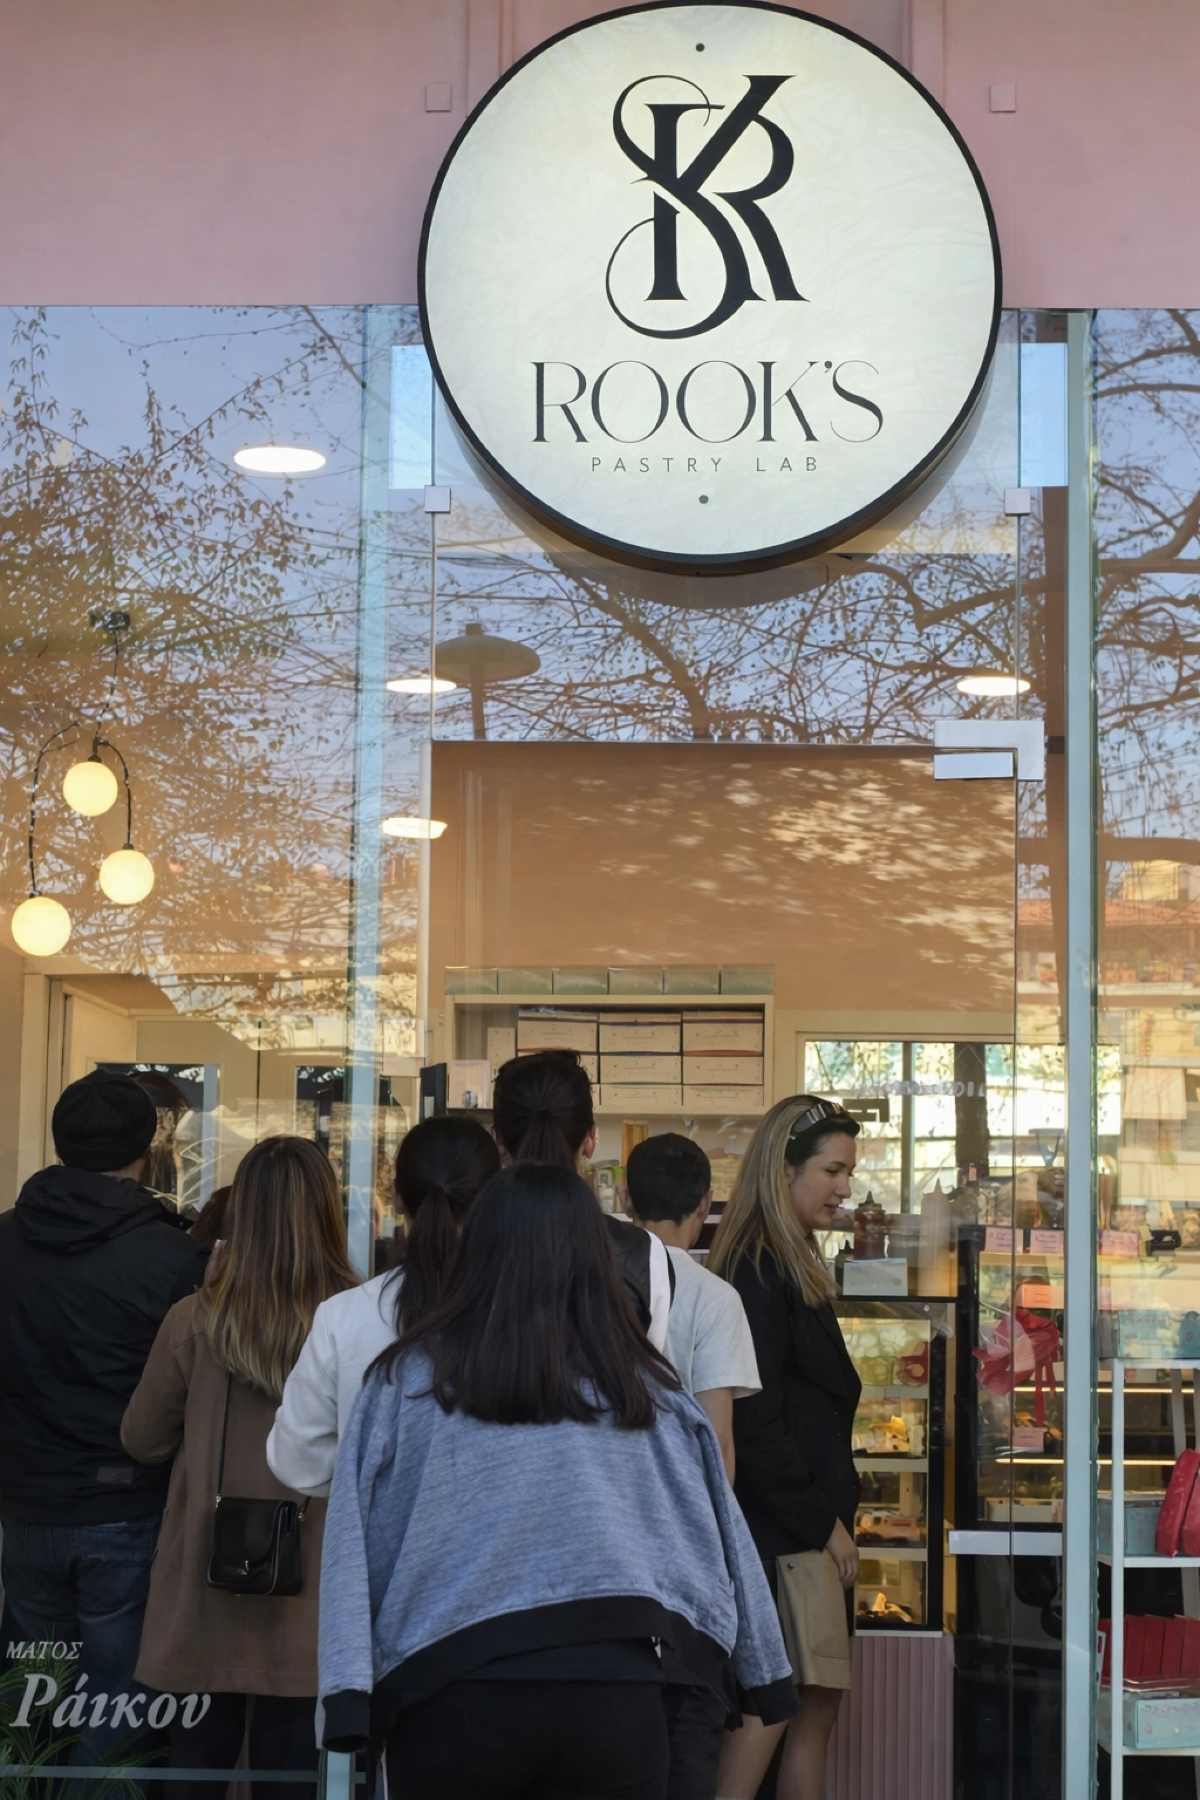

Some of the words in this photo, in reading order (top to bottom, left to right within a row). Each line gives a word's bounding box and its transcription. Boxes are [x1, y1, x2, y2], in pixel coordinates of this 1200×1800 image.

[529, 359, 885, 444] ROOK'S
[591, 456, 723, 473] PASTRY
[756, 456, 818, 473] LAB
